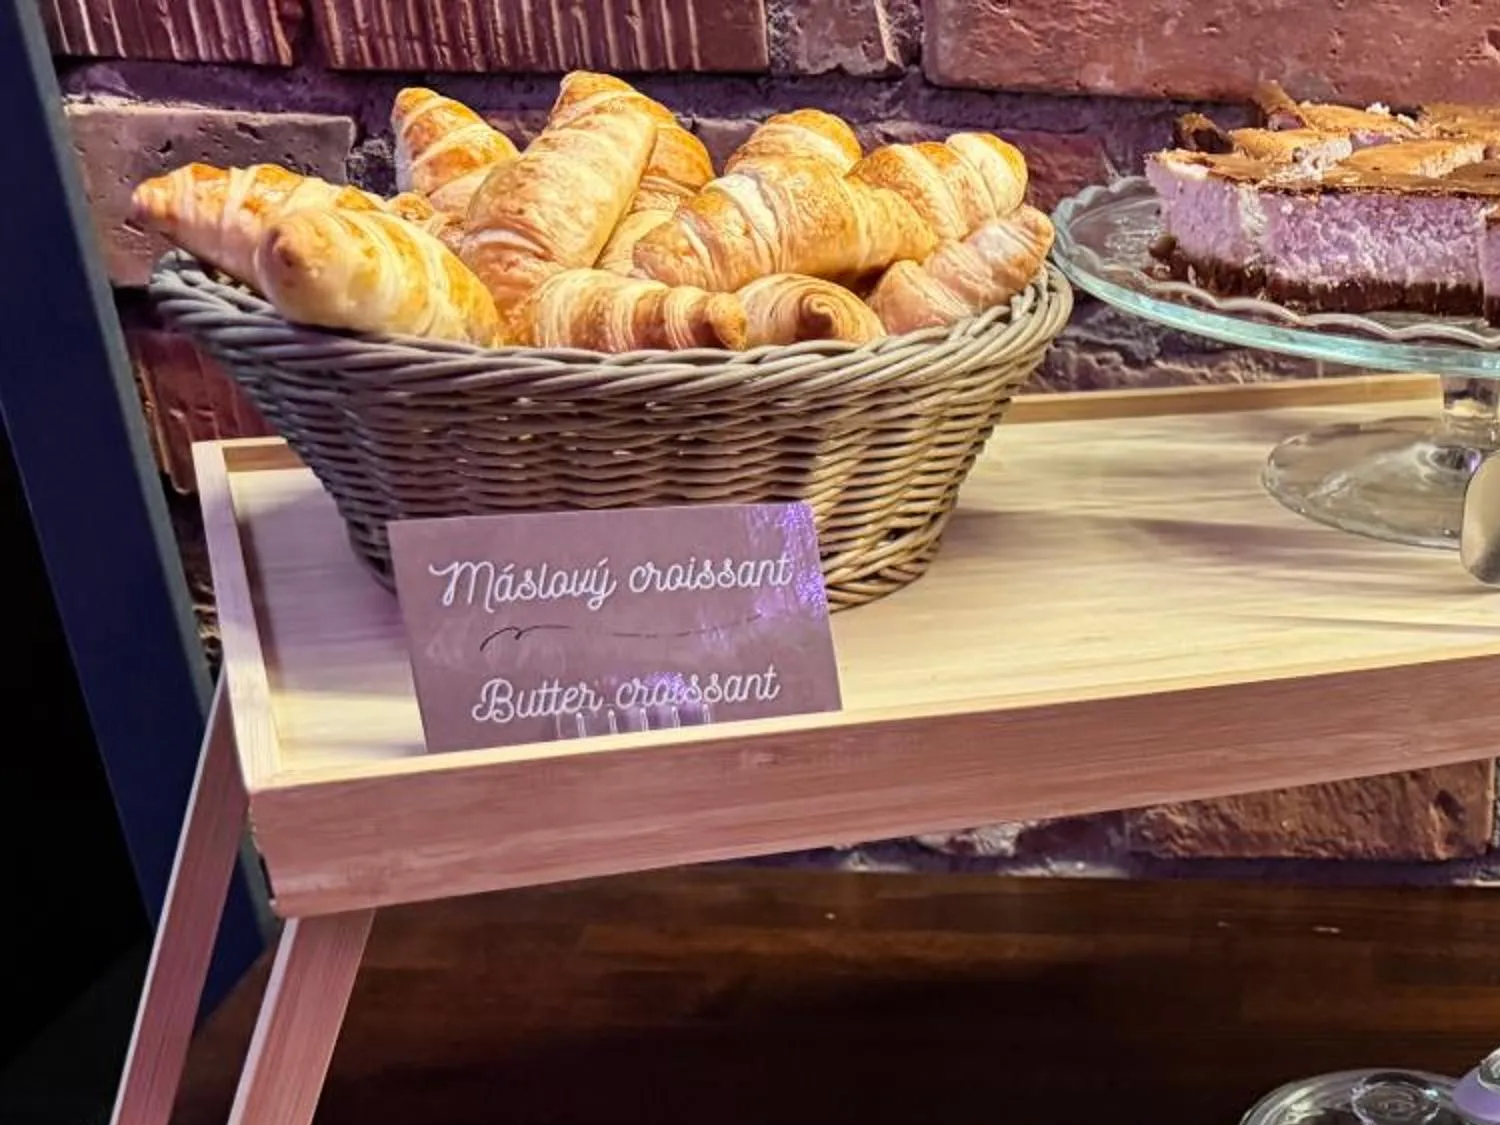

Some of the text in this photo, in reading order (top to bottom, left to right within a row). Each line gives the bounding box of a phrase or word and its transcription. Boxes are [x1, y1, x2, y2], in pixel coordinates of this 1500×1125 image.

[429, 553, 795, 613] Máslový croissant
[471, 664, 781, 723] Butter croissant
